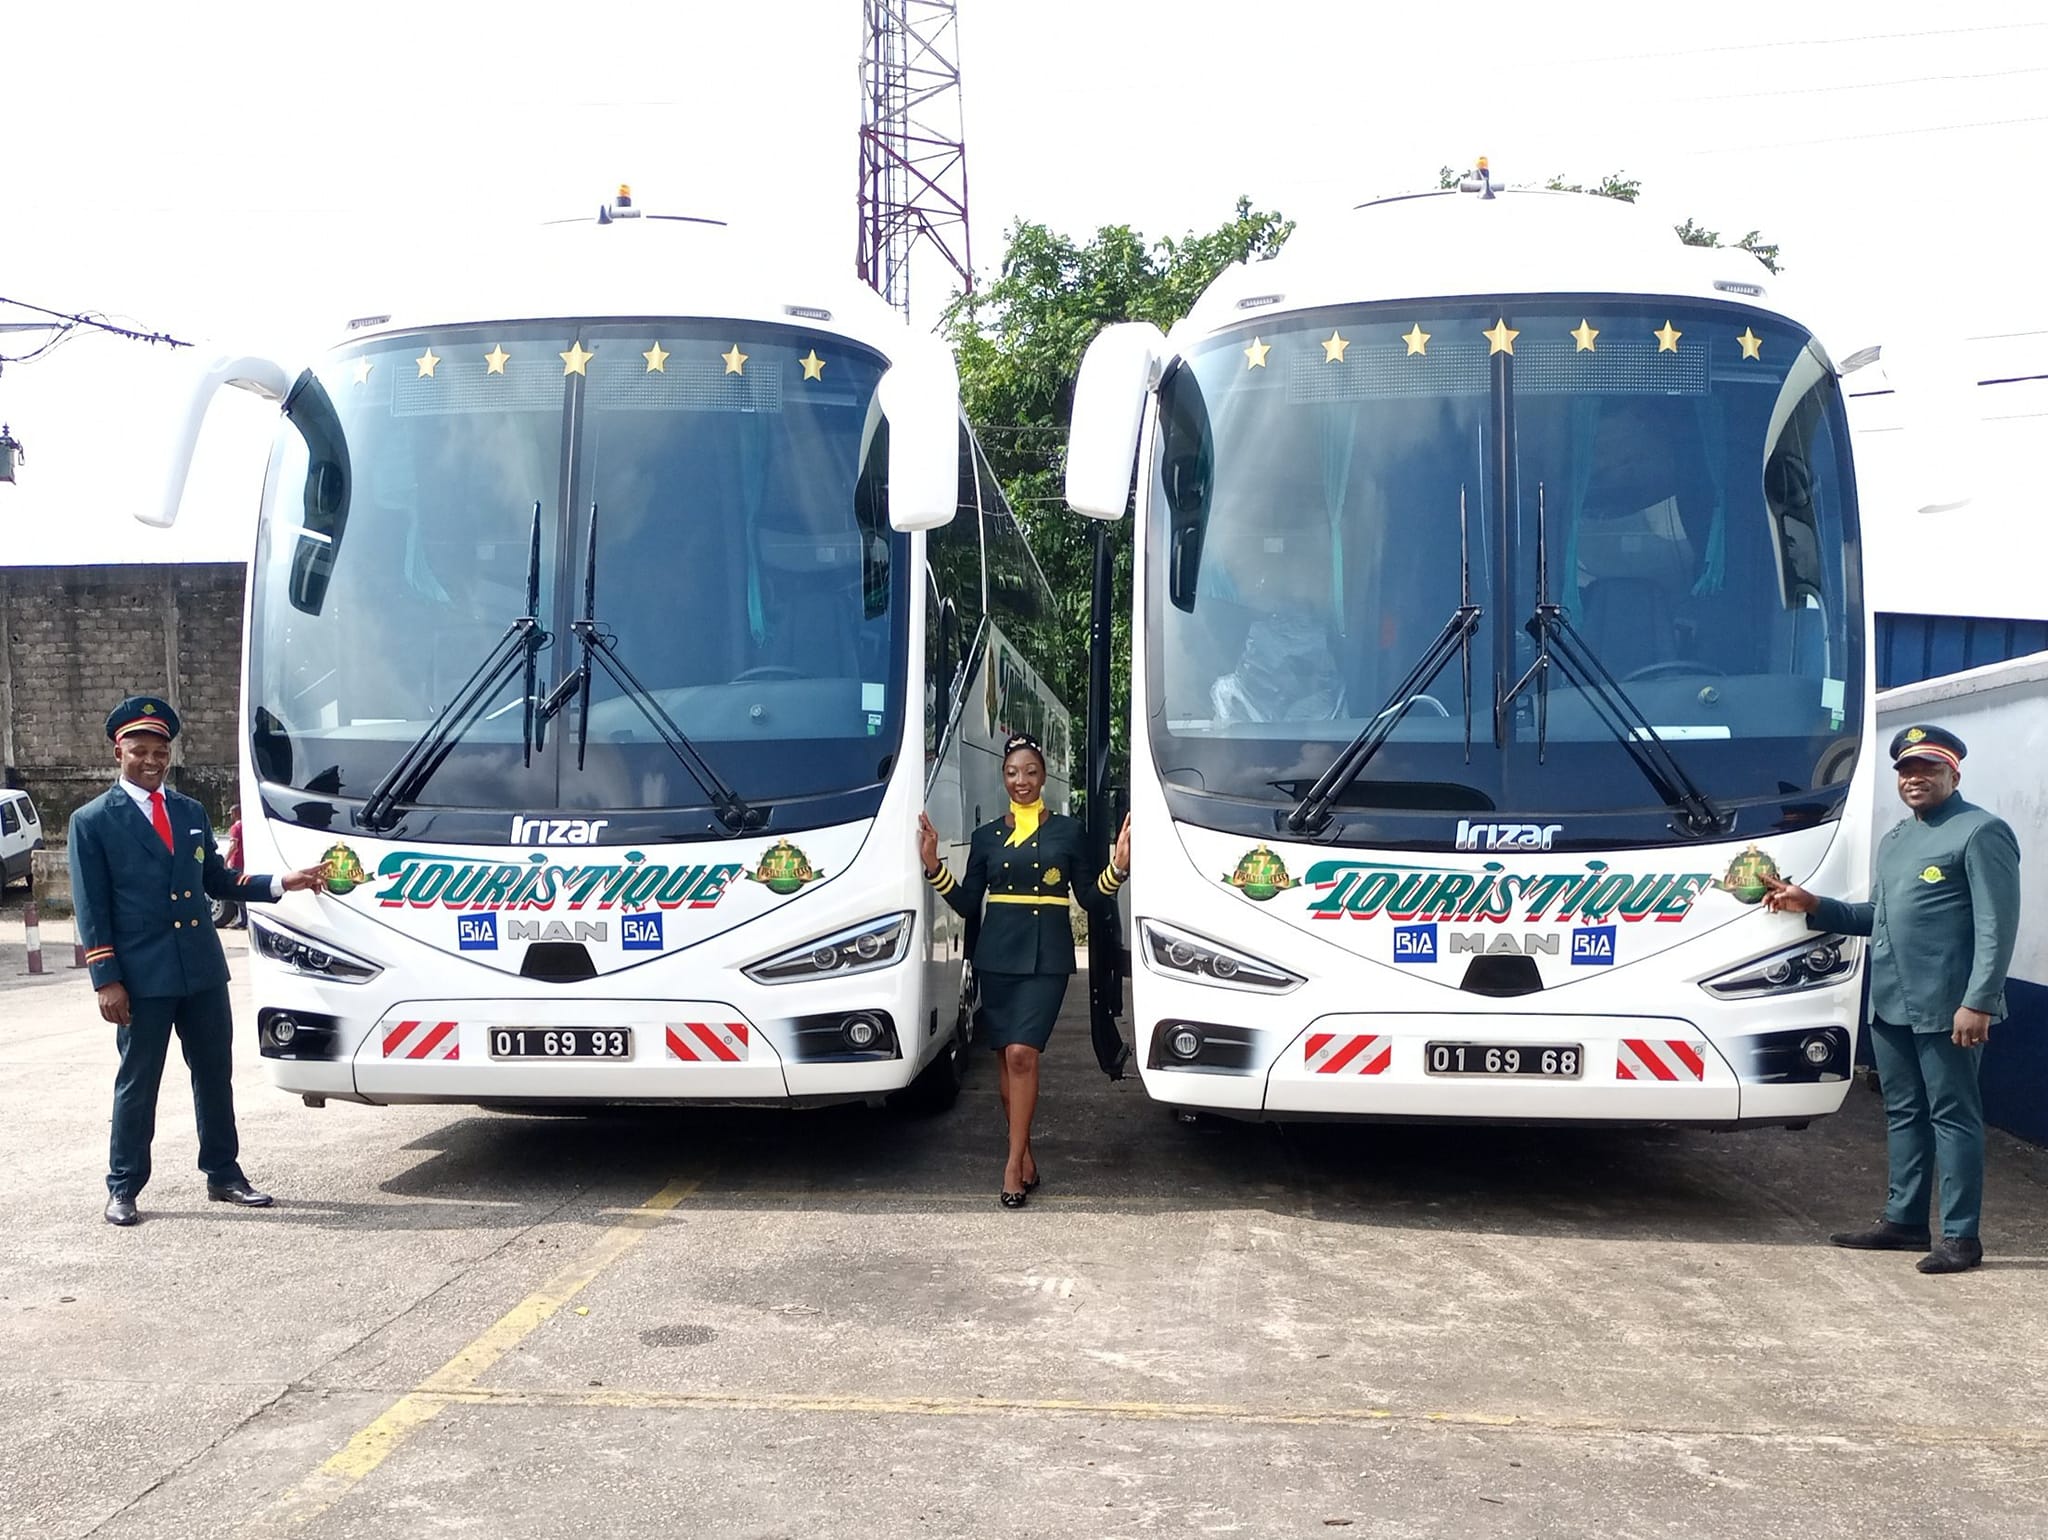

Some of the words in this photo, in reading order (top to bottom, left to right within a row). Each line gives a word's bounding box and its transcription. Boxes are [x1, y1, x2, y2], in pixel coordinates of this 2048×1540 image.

[510, 815, 609, 845] Irizar
[1455, 820, 1562, 850] Irizar
[374, 851, 745, 914] TOURISTIQUE
[1304, 860, 1714, 925] TOURISTIQUE
[507, 919, 608, 942] MAN
[1450, 932, 1560, 955] MAN
[496, 1031, 526, 1056] 01
[543, 1031, 577, 1056] 69
[591, 1031, 624, 1056] 93
[1433, 1046, 1466, 1072] 01
[1485, 1048, 1521, 1073] 69
[1541, 1050, 1577, 1075] 68
